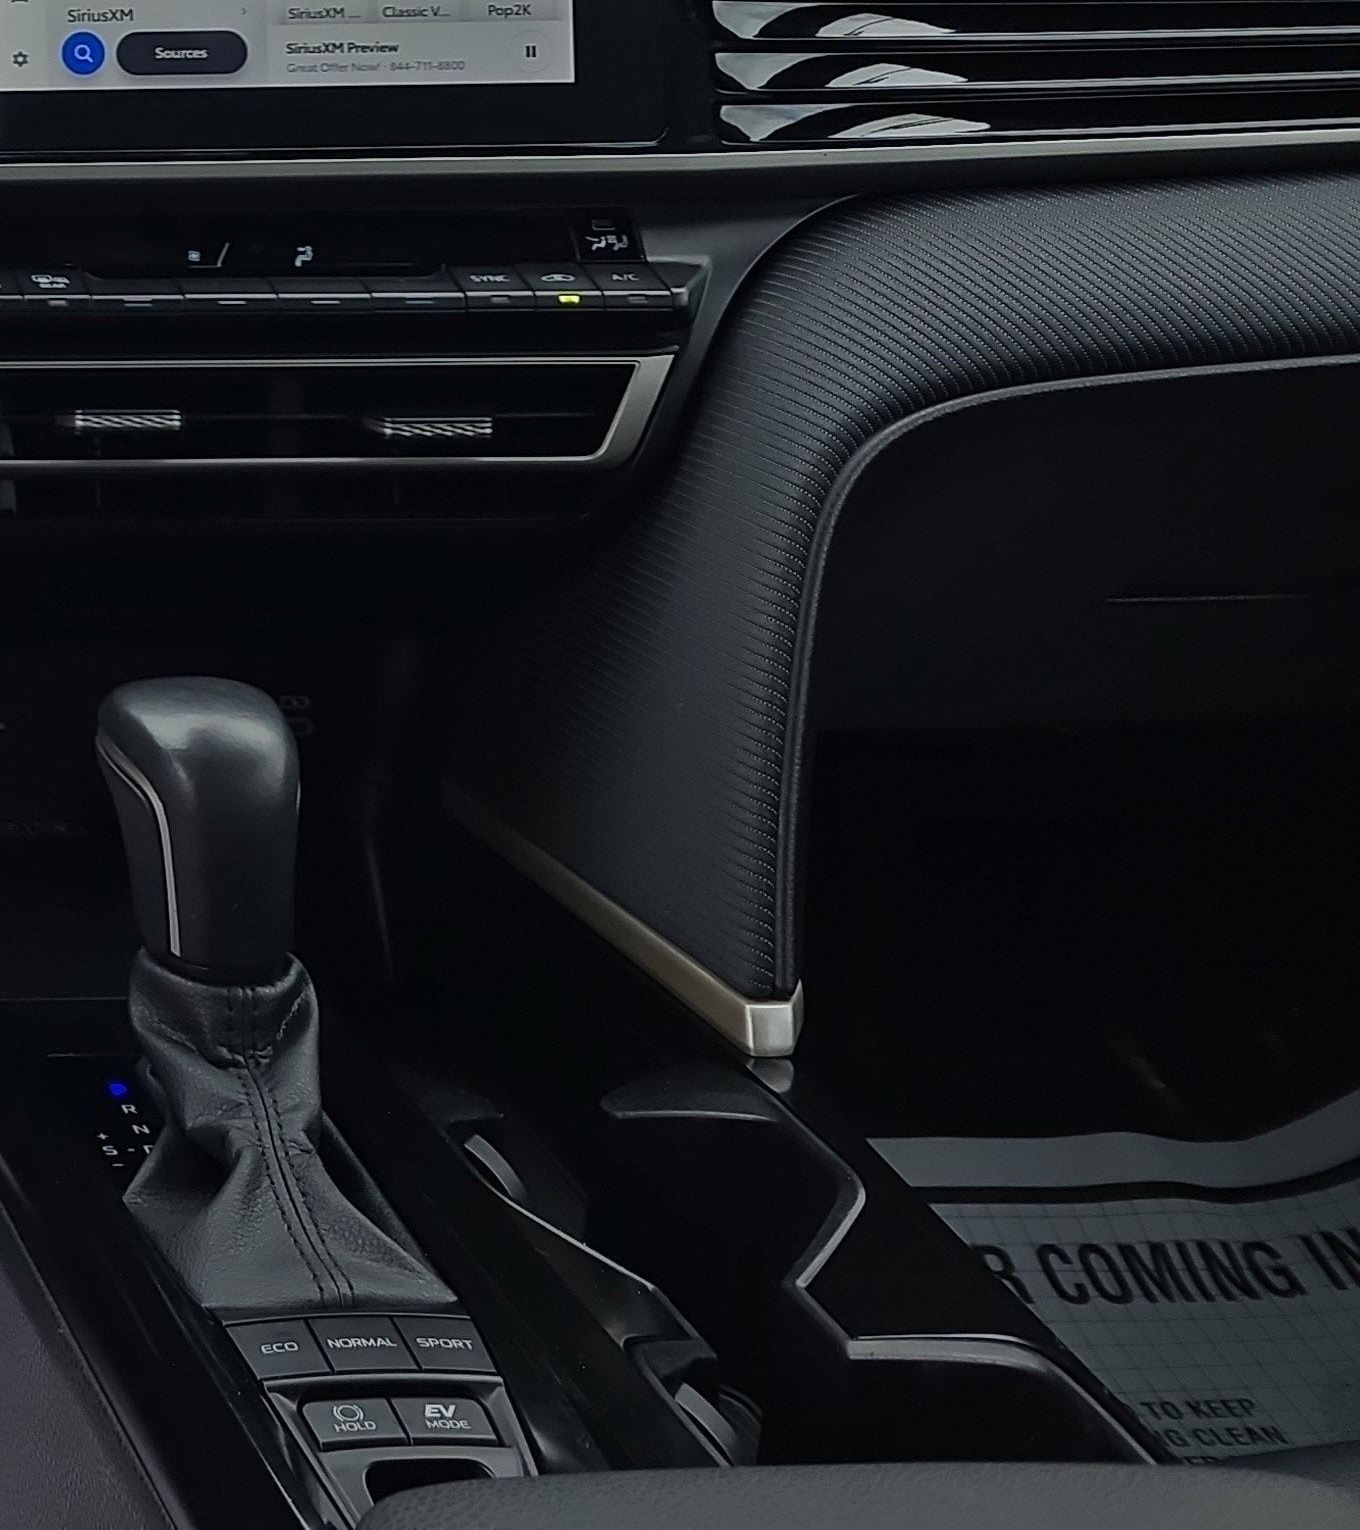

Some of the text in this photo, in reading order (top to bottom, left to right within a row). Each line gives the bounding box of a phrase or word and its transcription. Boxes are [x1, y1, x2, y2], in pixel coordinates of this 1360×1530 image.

[67, 9, 134, 23] SiriusXM
[288, 7, 344, 19] SiriusXM
[382, 6, 428, 18] Classic
[488, 4, 531, 18] Pop2K
[154, 46, 208, 60] Sources
[286, 41, 399, 55] SiriusXM Preview
[469, 274, 510, 283] SYNC
[612, 273, 639, 282] A/C
[121, 1104, 138, 1114] R
[132, 1124, 150, 1135] N
[1036, 1239, 1308, 1305] COMING
[260, 1337, 473, 1355] ECO NORMAL SPORT
[424, 1404, 456, 1418] EV
[1139, 1398, 1256, 1421] TO KEEP
[335, 1420, 376, 1433] HOLD
[425, 1418, 472, 1430] MODE
[1192, 1426, 1290, 1447] CLEAN
